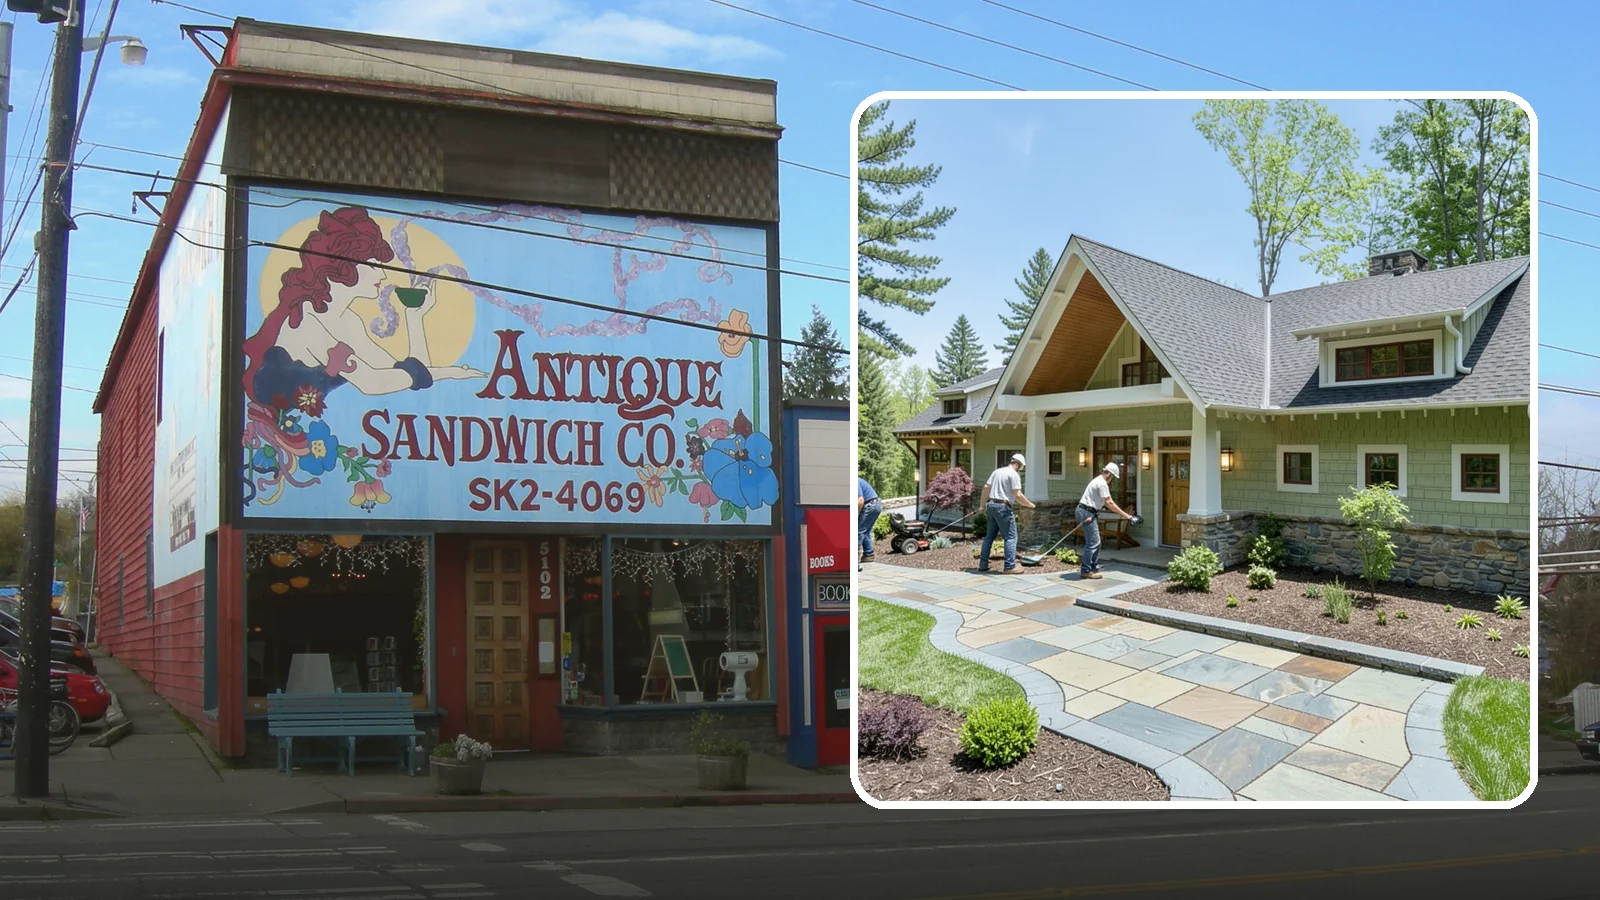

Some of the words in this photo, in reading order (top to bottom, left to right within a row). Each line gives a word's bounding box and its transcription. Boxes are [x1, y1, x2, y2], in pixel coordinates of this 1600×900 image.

[476, 329, 723, 420] ANTIQUE
[361, 408, 604, 467] SANDWICH
[617, 422, 684, 469] CO.
[468, 477, 645, 513] SK2-4069
[540, 542, 551, 600] 5102
[809, 555, 834, 569] BOOKS
